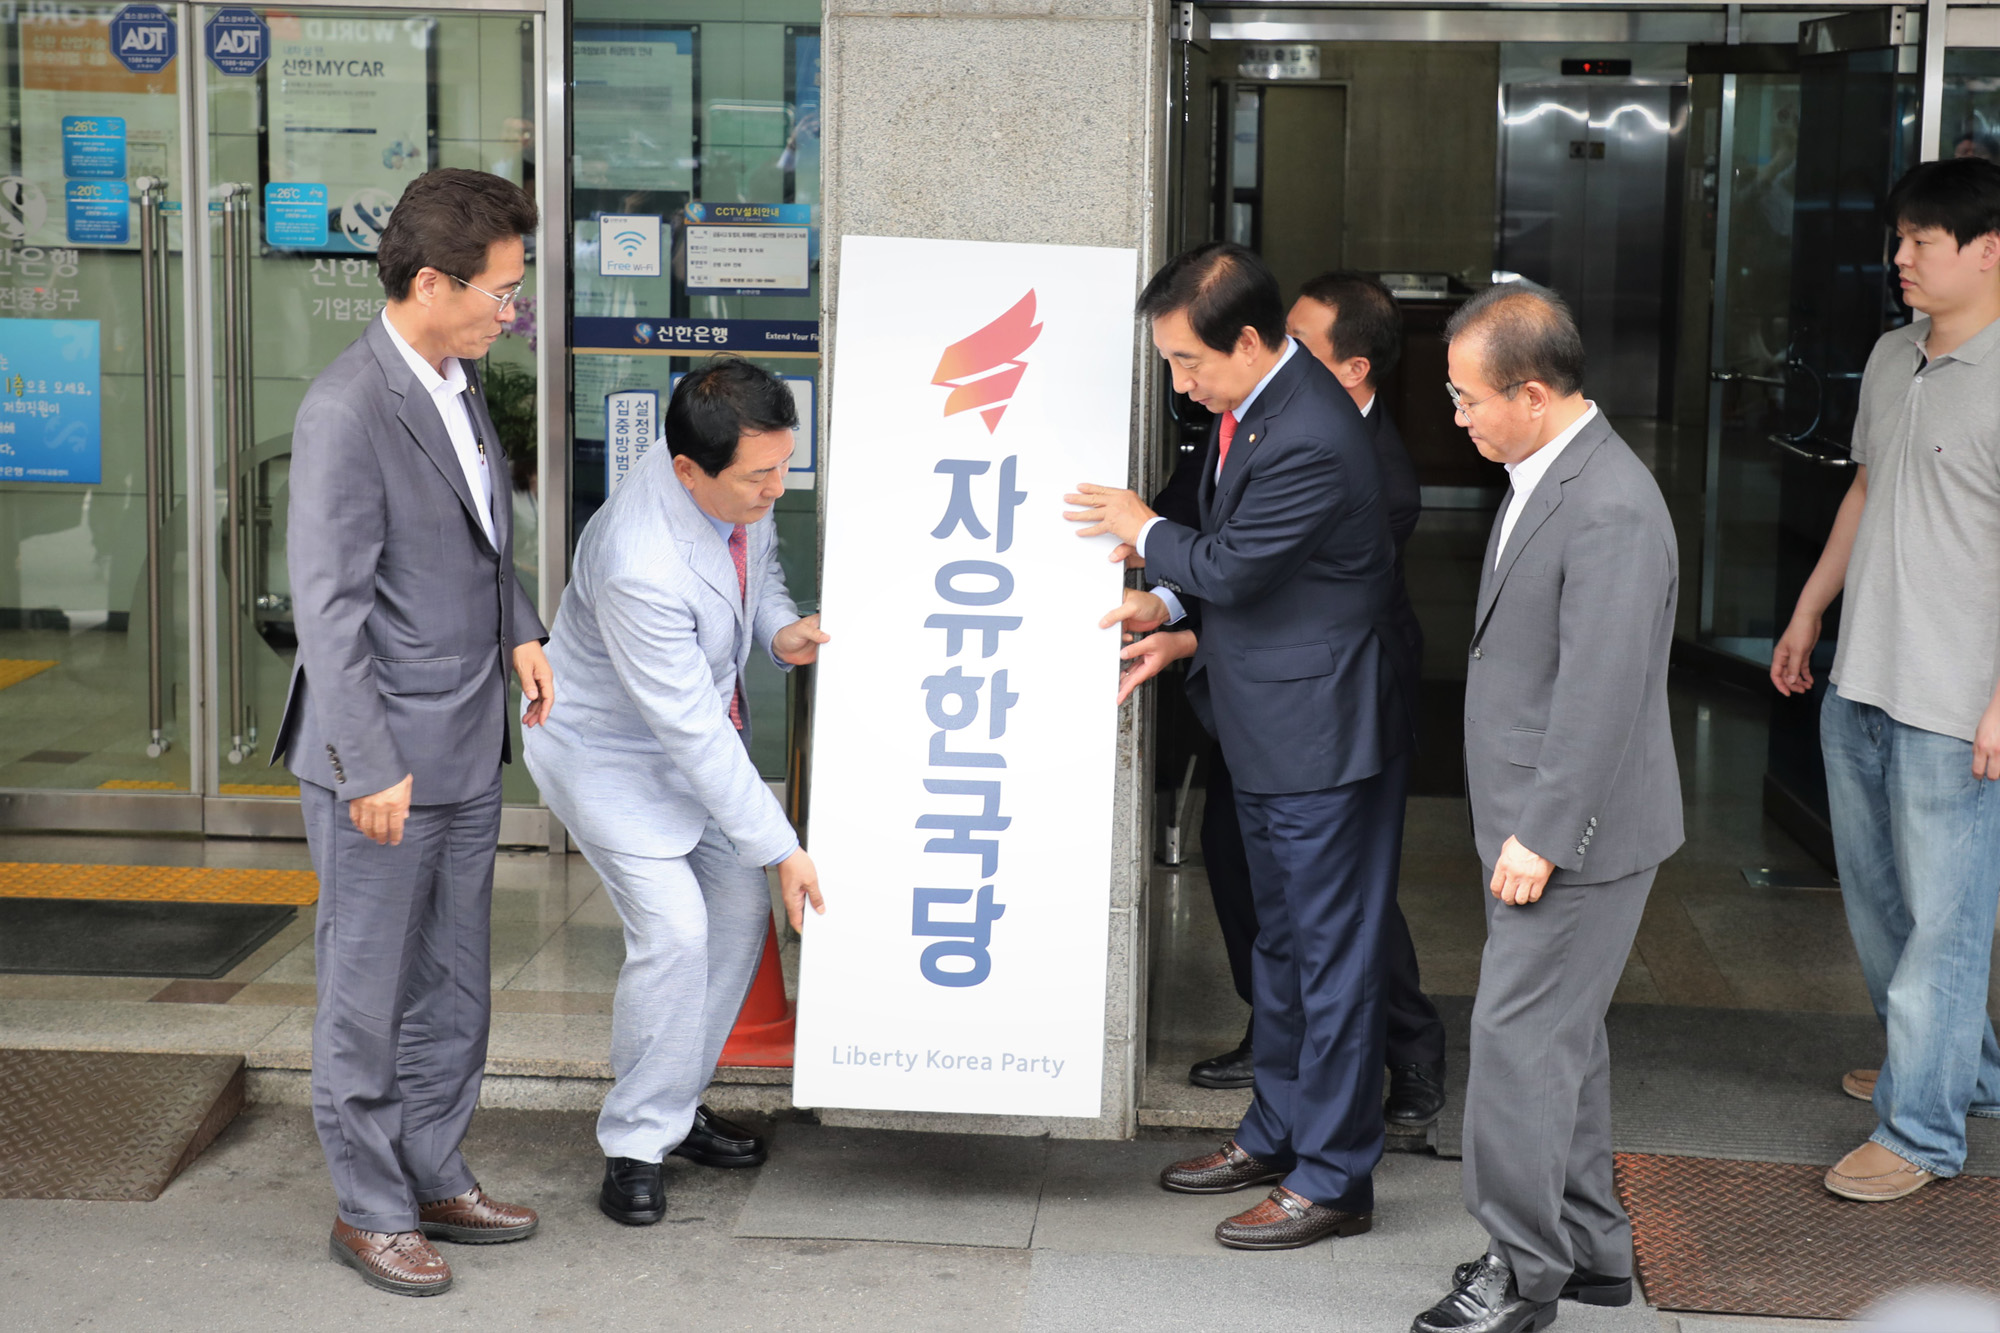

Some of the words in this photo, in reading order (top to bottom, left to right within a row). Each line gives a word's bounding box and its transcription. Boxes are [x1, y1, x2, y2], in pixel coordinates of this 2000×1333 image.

[120, 26, 168, 51] ADT
[214, 30, 261, 54] ADT
[347, 60, 385, 77] CAR
[715, 206, 780, 218] CCTV설치안내
[309, 258, 385, 288] 신한
[607, 260, 631, 271] Free
[633, 263, 653, 272] Wi-Fi
[657, 325, 728, 344] 신한은행
[765, 331, 791, 340] Extend
[792, 332, 809, 341] Your
[3, 398, 60, 418] 저희직원이
[911, 454, 1028, 988] 자유한국당
[832, 1045, 918, 1072] Liberty
[926, 1049, 993, 1071] Korea
[1001, 1052, 1065, 1079] Party
